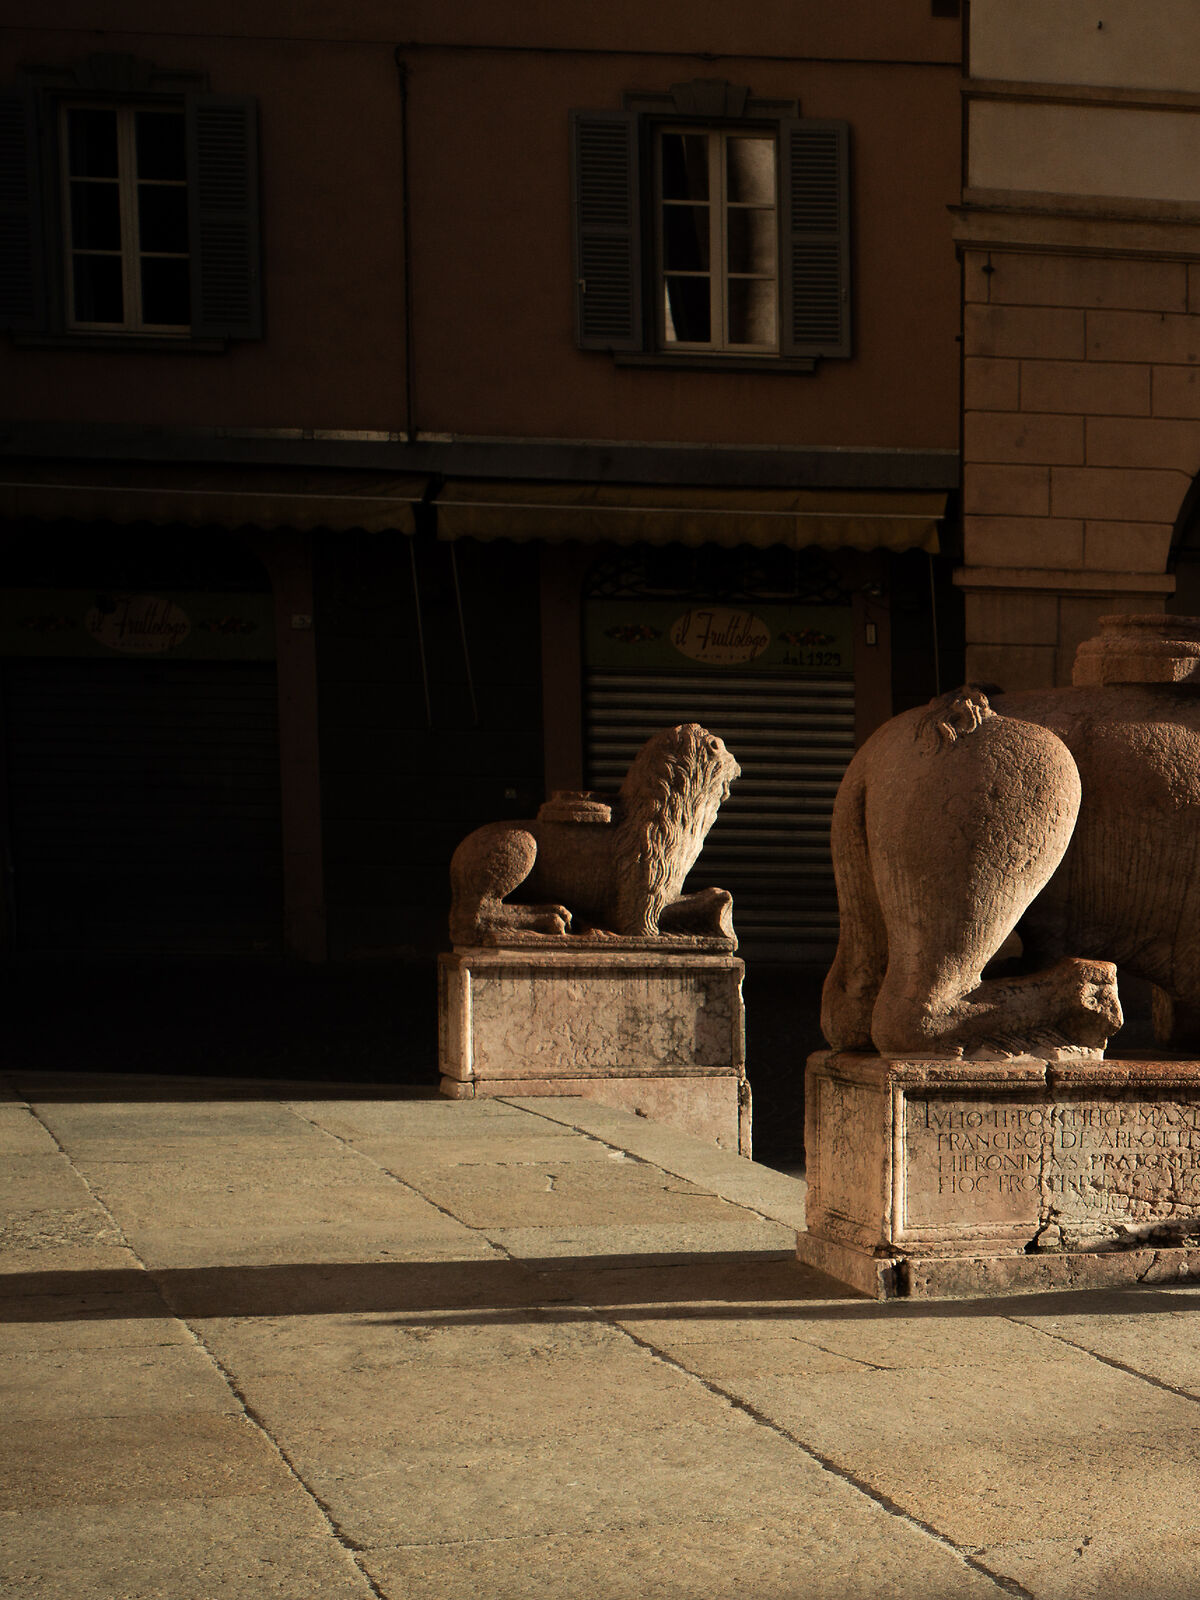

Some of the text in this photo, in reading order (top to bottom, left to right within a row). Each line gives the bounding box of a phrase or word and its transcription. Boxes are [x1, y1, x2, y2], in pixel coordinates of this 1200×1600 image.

[675, 608, 768, 662] il Fruttologo
[938, 1175, 989, 1194] HOC
